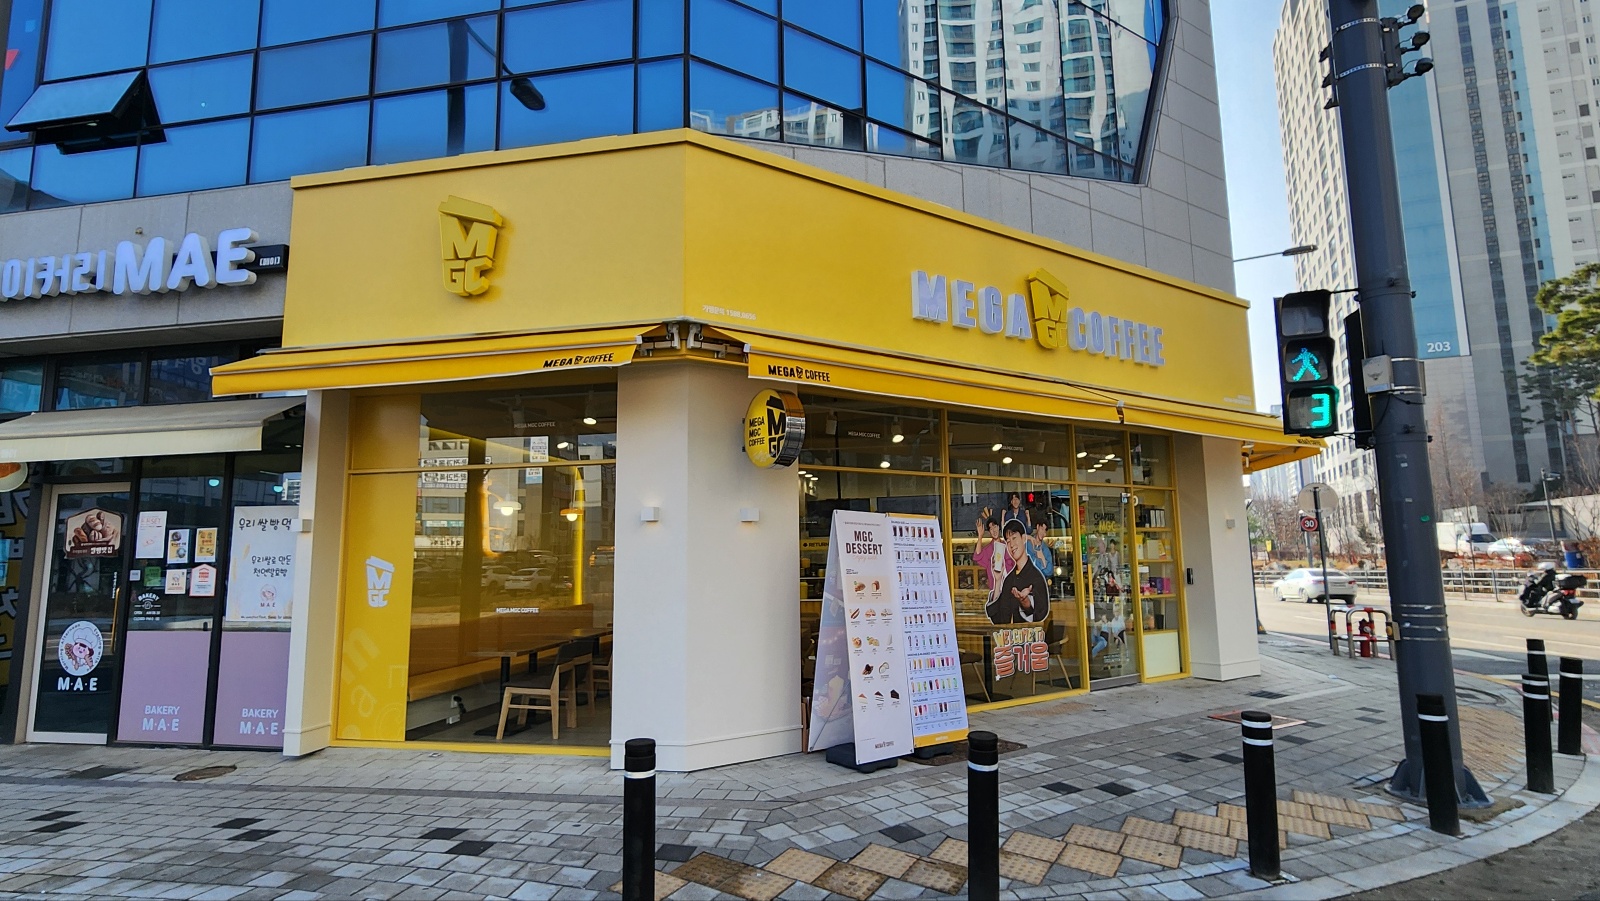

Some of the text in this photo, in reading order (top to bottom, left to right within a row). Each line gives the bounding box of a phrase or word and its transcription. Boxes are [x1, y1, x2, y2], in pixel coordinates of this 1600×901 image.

[113, 227, 259, 295] MAE
[910, 269, 1166, 367] MEGA COFFEE
[1426, 341, 1451, 353] 203
[543, 352, 614, 368] MEGA COFFEE
[768, 365, 831, 382] MEGA COFFEE
[1311, 393, 1331, 427] 3
[749, 416, 765, 427] MEGA
[749, 428, 762, 438] MGC
[749, 438, 765, 447] COFFEE
[239, 518, 255, 530] 우리
[1304, 520, 1315, 528] 30
[854, 530, 873, 543] MGC
[845, 542, 883, 555] DESSERT
[251, 554, 292, 566] 우리쌀로 만든
[137, 593, 160, 602] BAKERY
[993, 628, 1034, 647] WELCOME
[994, 641, 1050, 681] 즐거움
[145, 705, 180, 715] BAKERY
[242, 708, 279, 718] BAKERY
